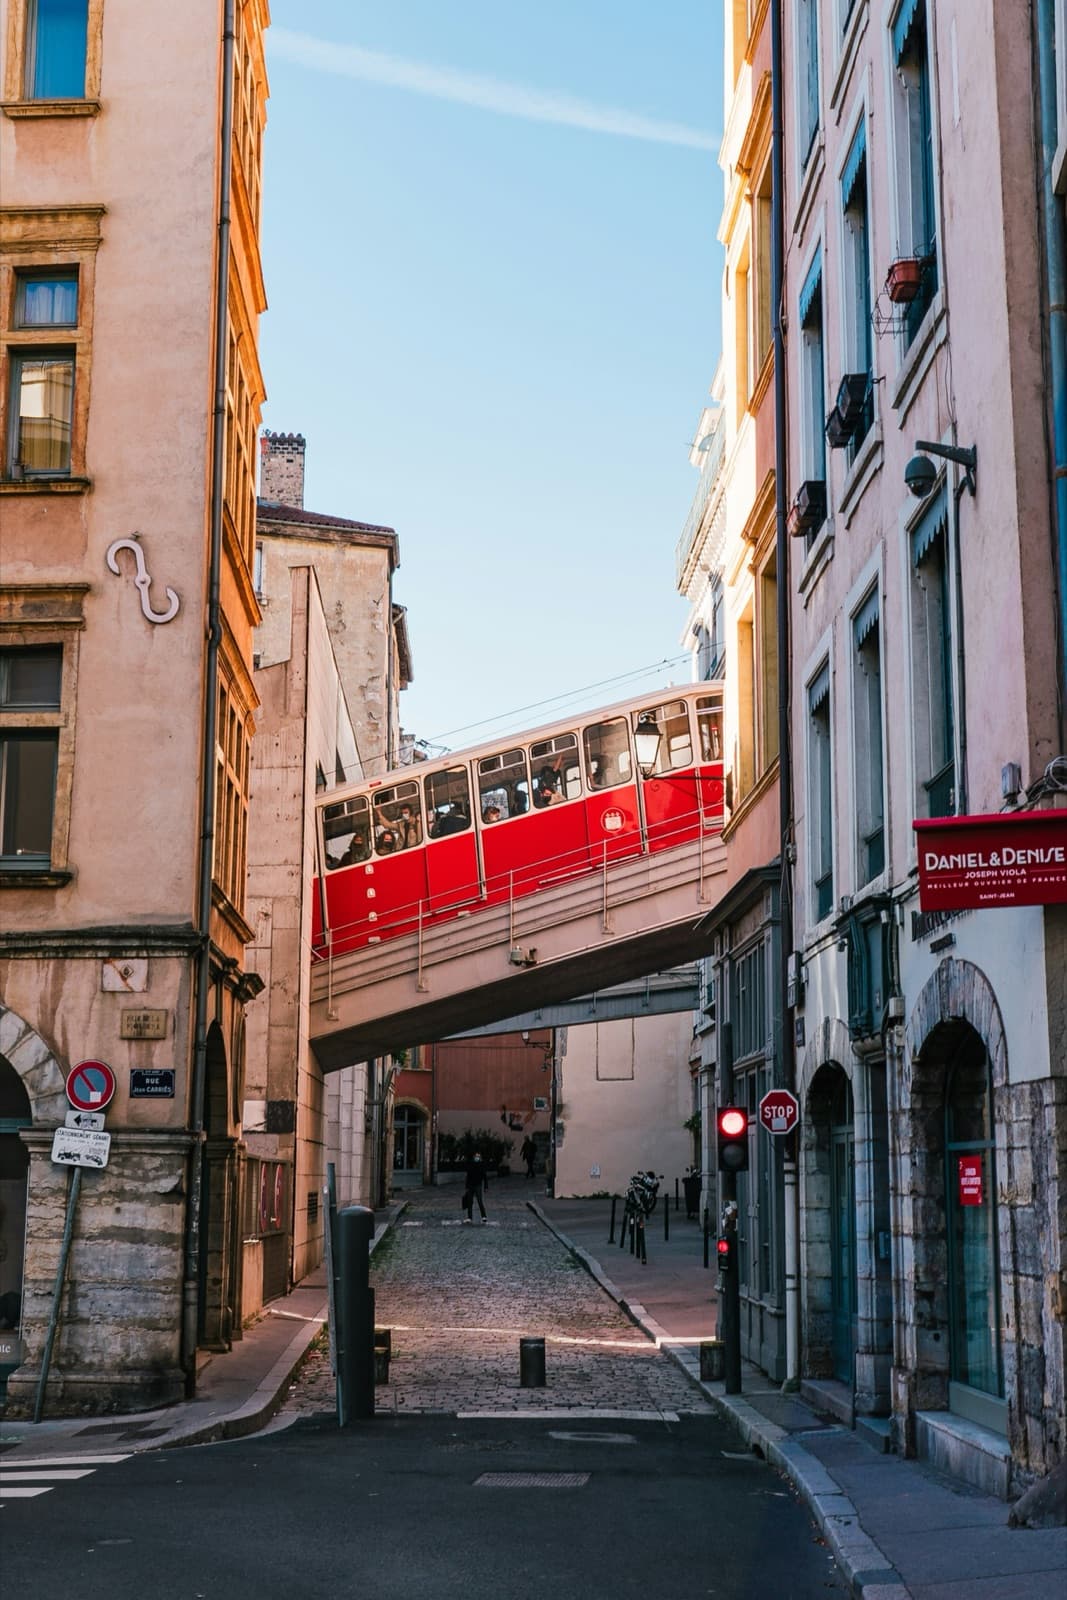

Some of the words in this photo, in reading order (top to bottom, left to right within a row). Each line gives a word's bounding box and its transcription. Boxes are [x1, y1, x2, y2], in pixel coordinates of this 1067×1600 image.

[965, 871, 997, 879] JOSEPH
[1000, 868, 1027, 877] VIOLA
[927, 881, 969, 889] MEILLEUR
[1032, 875, 1067, 883] FRANCE
[979, 892, 1015, 900] SAINT-JEAN
[764, 1105, 794, 1119] STOP
